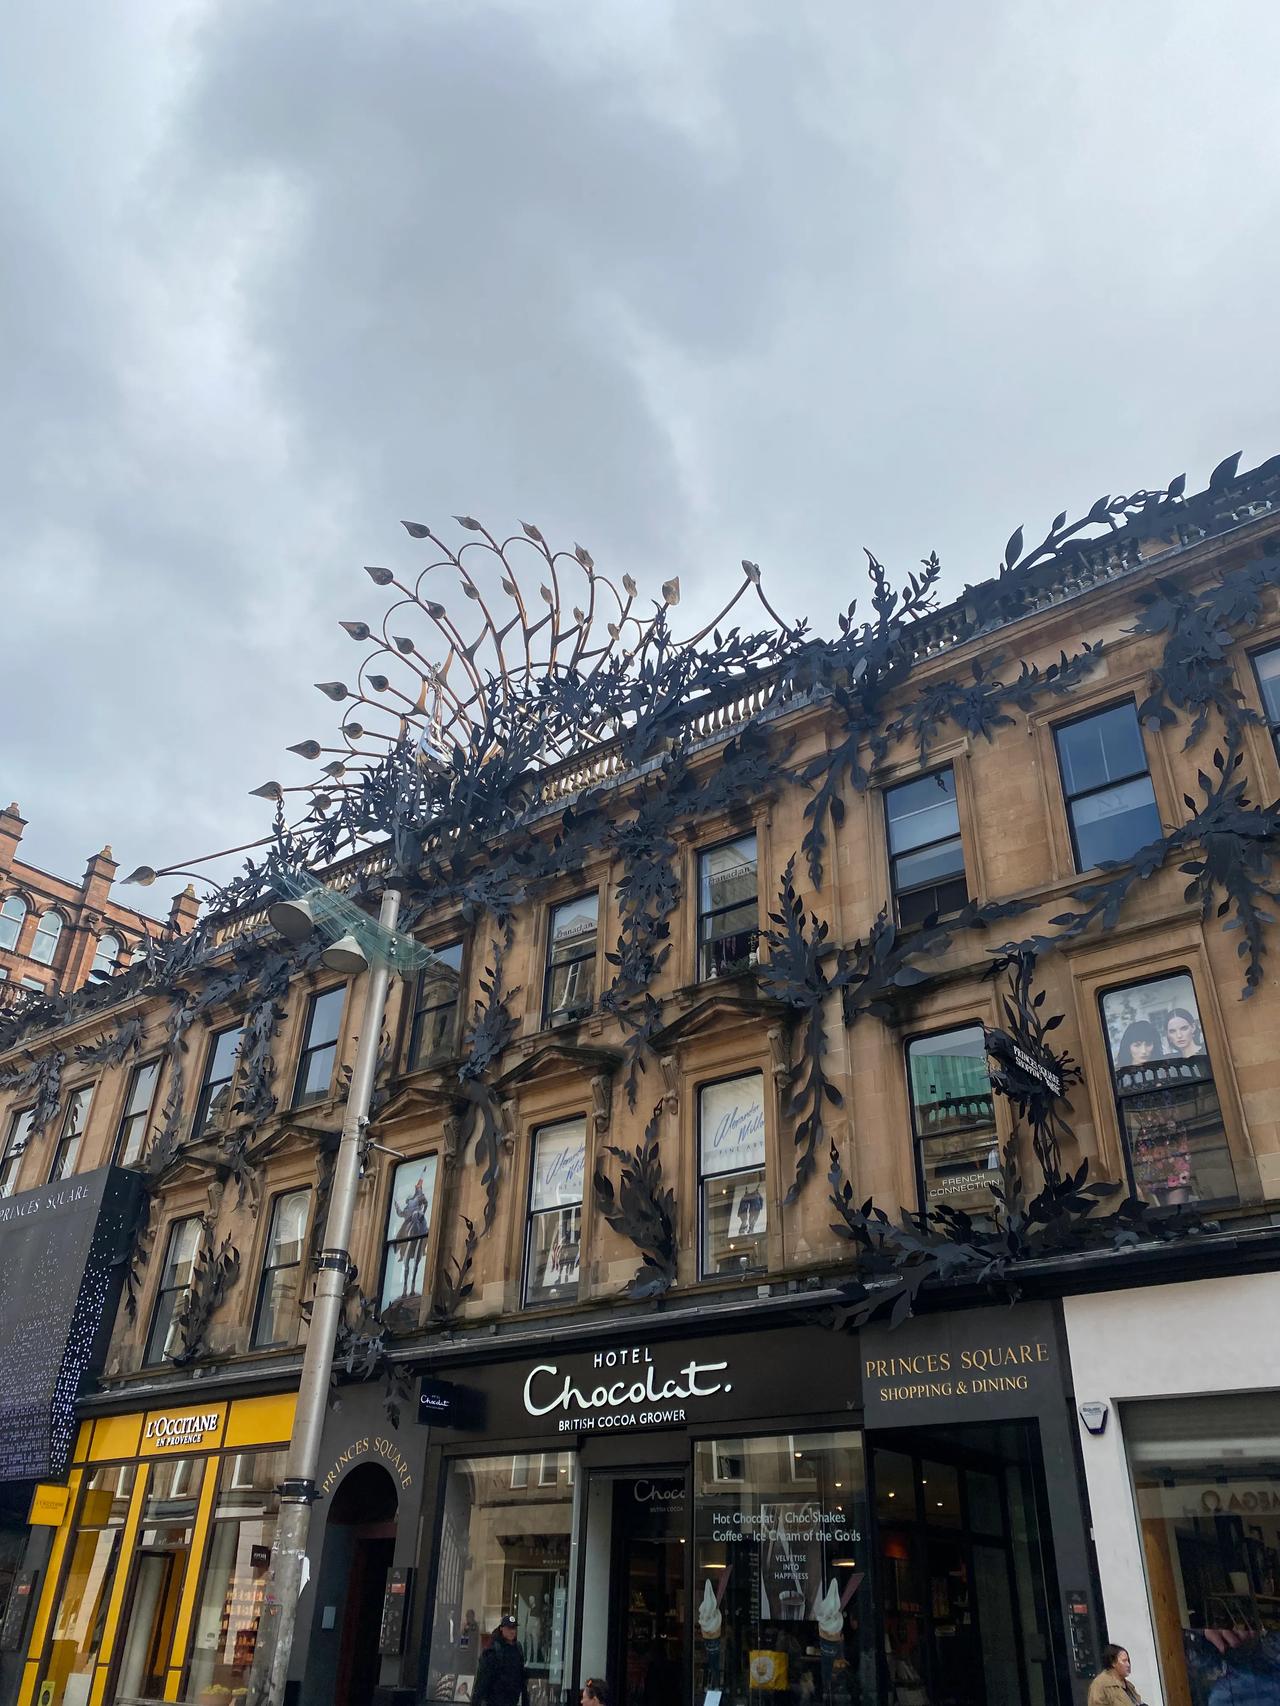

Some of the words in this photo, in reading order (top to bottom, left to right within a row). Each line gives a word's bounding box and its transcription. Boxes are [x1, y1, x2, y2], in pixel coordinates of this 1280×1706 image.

[929, 1179, 1000, 1197] CONNECTION
[942, 1172, 985, 1187] FRENCH
[593, 1348, 653, 1369] HOTEL
[866, 1352, 951, 1379] PRINCES
[960, 1343, 1050, 1372] SQUARE
[880, 1382, 952, 1402] SHOPPING
[956, 1380, 968, 1395] &
[972, 1375, 1028, 1393] DINING
[558, 1417, 595, 1432] BRITISH
[597, 1413, 637, 1428] COCOA
[639, 1409, 686, 1425] GROWER
[156, 1437, 166, 1447] EN
[166, 1433, 202, 1446] PROVENCE
[322, 1437, 369, 1494] PRINCES
[373, 1436, 413, 1490] SQUARE
[712, 1513, 731, 1525] Hot
[732, 1512, 774, 1524] Chocoat
[785, 1511, 810, 1523] Choc
[812, 1511, 846, 1523] Shakes
[712, 1530, 743, 1542] Coffee
[753, 1531, 766, 1542] Ice
[768, 1530, 800, 1542] Cram
[803, 1529, 814, 1542] of
[816, 1530, 832, 1542] the
[834, 1529, 861, 1542] Gods
[783, 1563, 800, 1571] INTO
